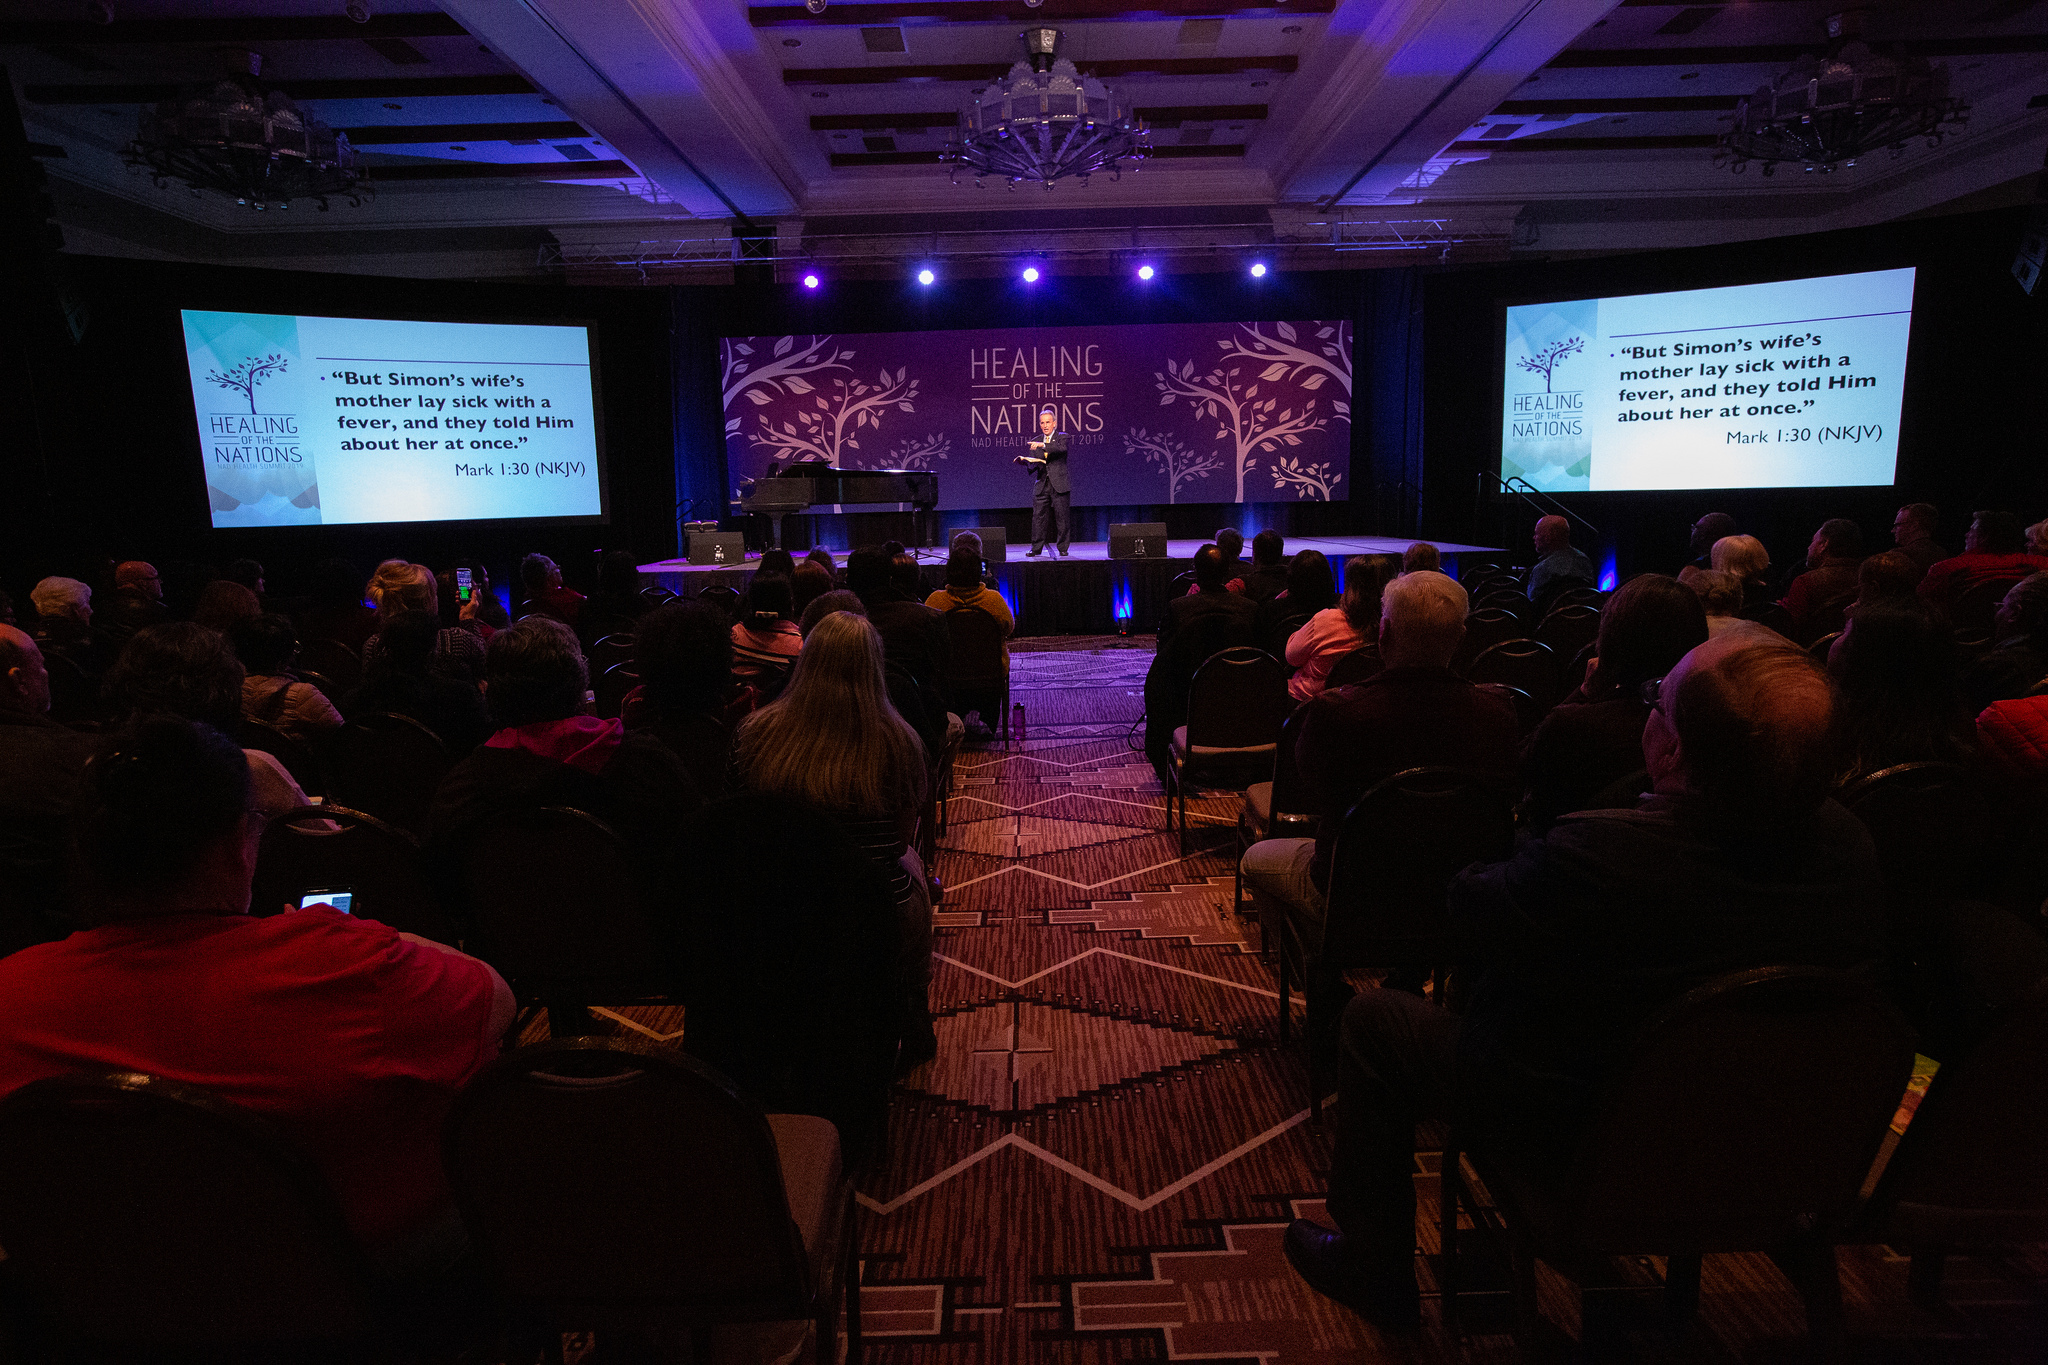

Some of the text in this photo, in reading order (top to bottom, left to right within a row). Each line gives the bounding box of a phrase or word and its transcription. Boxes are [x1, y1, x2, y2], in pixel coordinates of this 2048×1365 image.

[1621, 333, 1822, 359] “But Simon’s wife’s
[971, 344, 1103, 379] HEALING
[1620, 354, 1851, 381] mother lay sick with a
[332, 371, 525, 387] “But Simon’s wife’s
[1013, 382, 1062, 399] OF THE
[1619, 375, 1876, 402] fever, and they told Him
[335, 394, 551, 412] mother lay sick with a
[1513, 393, 1583, 411] HEALING
[1617, 400, 1815, 422] about her at once.”
[337, 415, 574, 433] fever, and they told Him
[1534, 411, 1561, 420] OF THE
[210, 416, 298, 434] HEALING
[1513, 420, 1583, 437] NATIONS
[241, 435, 275, 445] OF THE
[340, 436, 528, 451] about her at once.”
[971, 437, 991, 448] NAD
[1079, 434, 1104, 445] 2019
[1726, 424, 1883, 445] Mark 1:30 (NKJV)
[215, 446, 303, 463] NATIONS
[455, 461, 586, 478] Mark 1:30 (NKJV)
